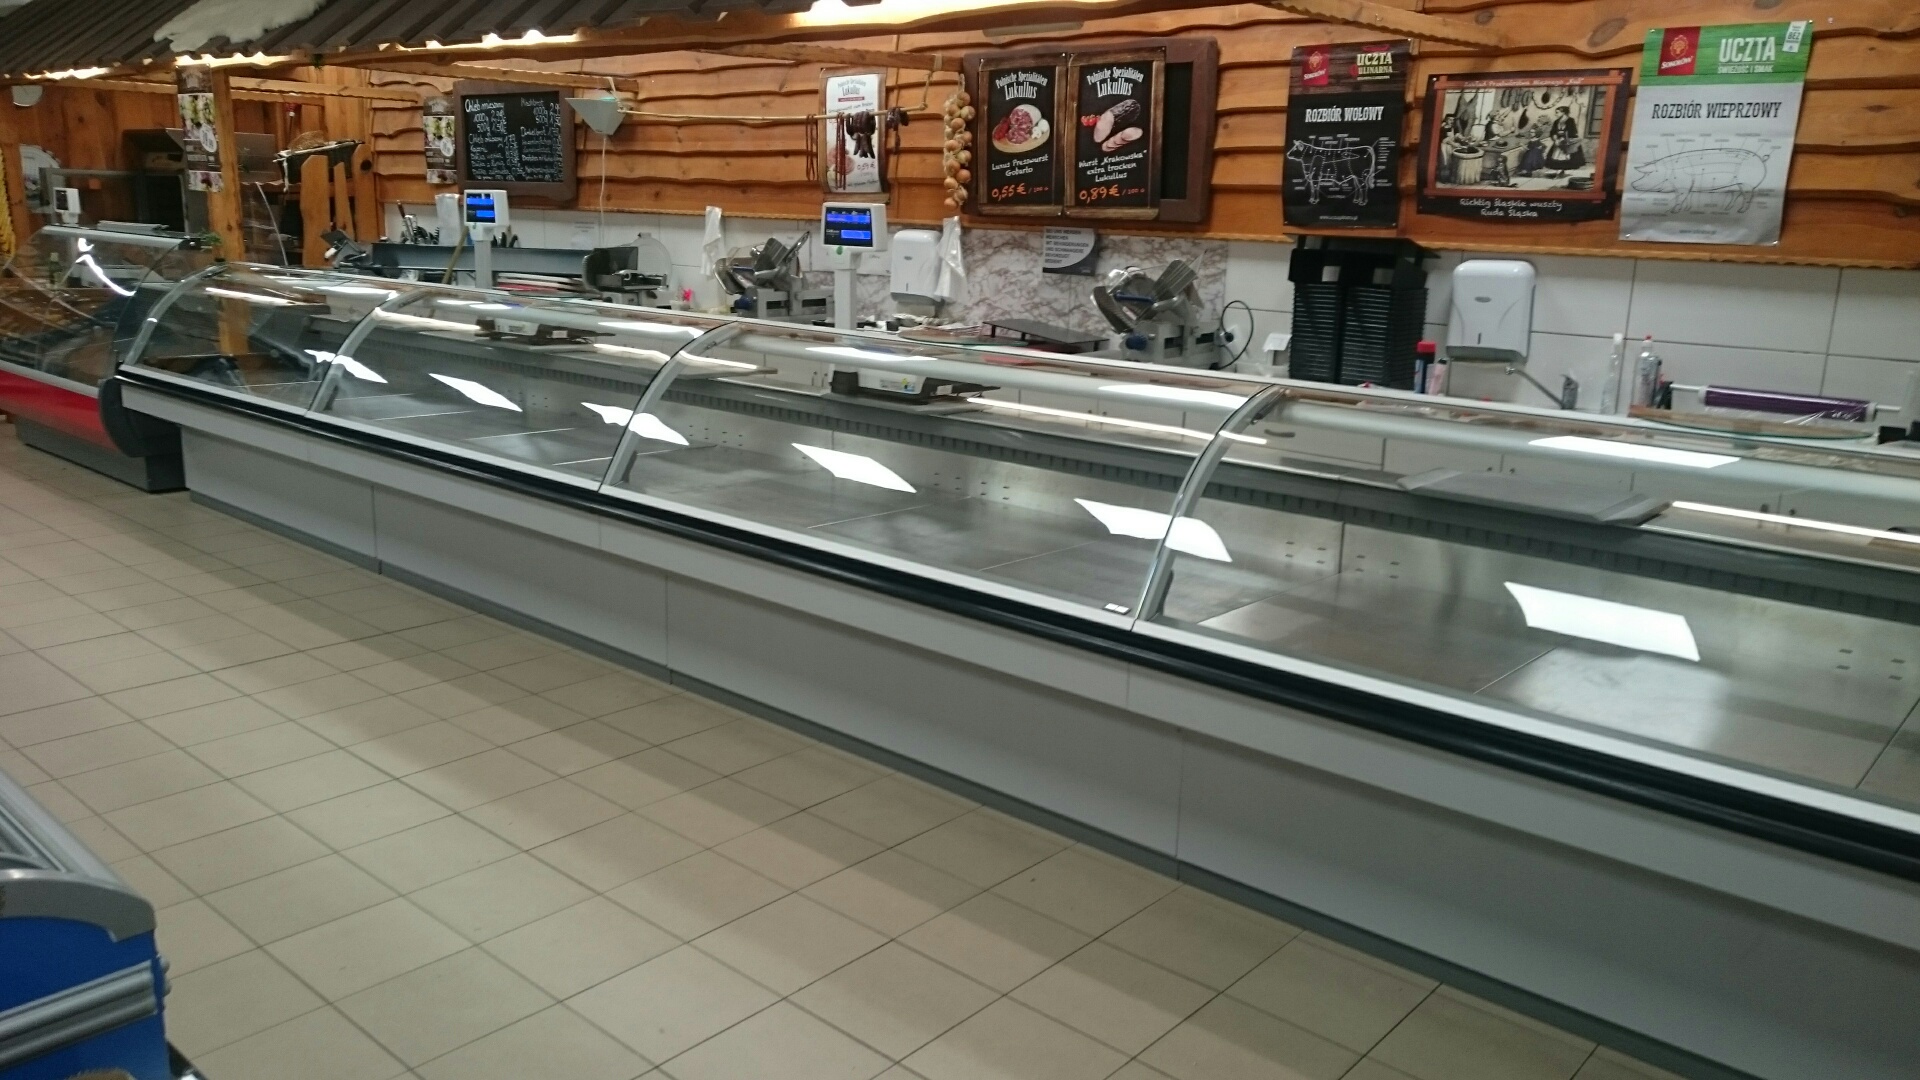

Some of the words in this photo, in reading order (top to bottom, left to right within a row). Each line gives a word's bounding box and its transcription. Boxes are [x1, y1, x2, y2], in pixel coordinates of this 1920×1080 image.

[1787, 31, 1801, 40] BEZ
[1718, 36, 1776, 63] UCZTA
[1356, 52, 1393, 66] UCZTA
[995, 72, 1017, 89] Polnische
[1086, 68, 1111, 85] Polnische
[1112, 66, 1144, 83] Spezialitäten
[1004, 81, 1038, 100] Lukullus
[1096, 77, 1134, 98] Lukullus
[1304, 105, 1342, 123] ROZBIÓR
[1344, 106, 1385, 122] WOŁOWY
[1652, 100, 1702, 119] ROZBIÓR
[1706, 101, 1782, 119] WIEPRZOWY
[1012, 153, 1049, 167] Presswurst
[1078, 157, 1098, 168] Wurst
[1086, 166, 1105, 176] extra
[1107, 162, 1137, 173] trocken
[1095, 171, 1128, 183] Lukullus
[1460, 198, 1492, 209] Richtig
[1481, 207, 1505, 217] Ruda
